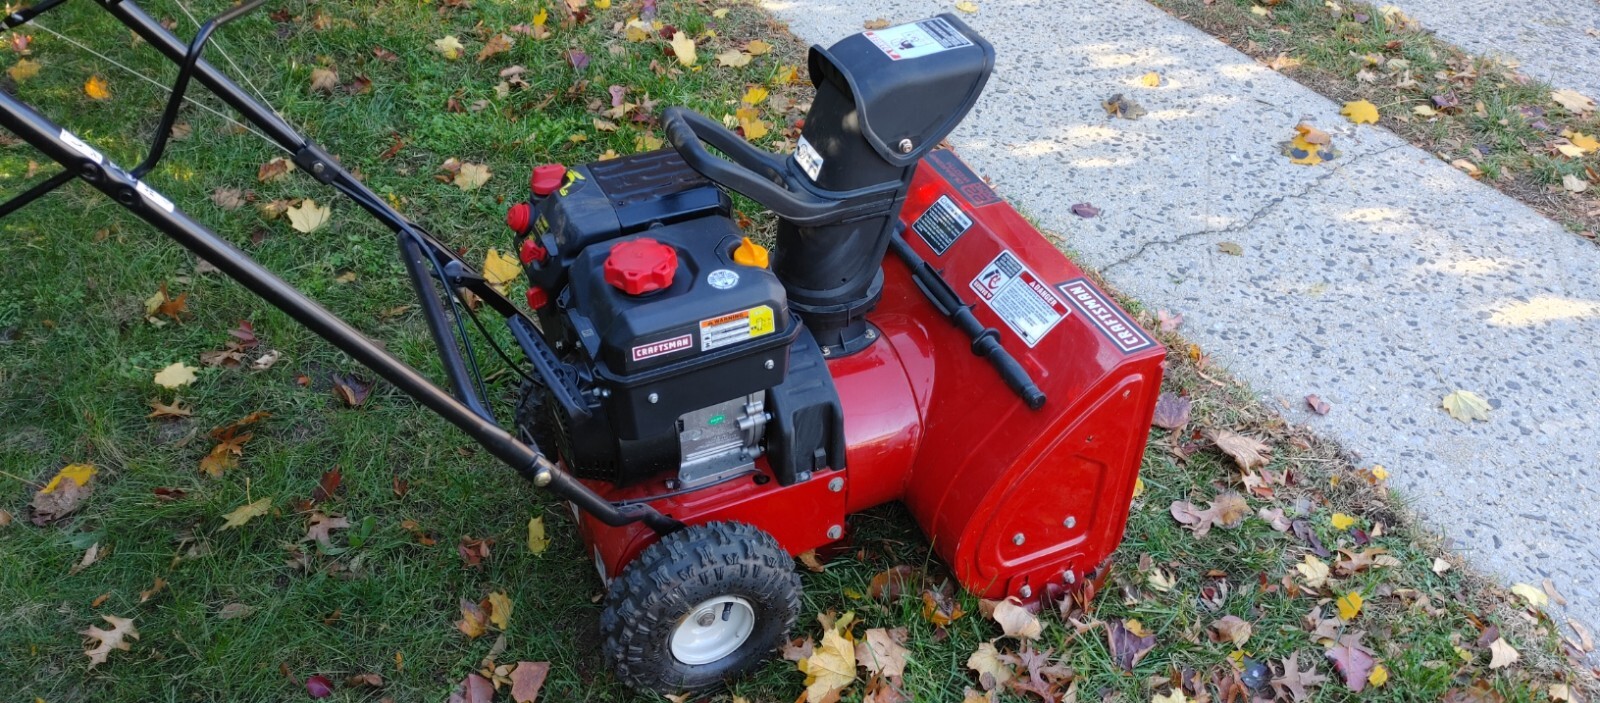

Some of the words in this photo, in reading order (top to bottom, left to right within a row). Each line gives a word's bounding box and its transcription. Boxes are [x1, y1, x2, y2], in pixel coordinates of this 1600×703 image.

[1034, 283, 1058, 307] DANGER
[714, 312, 744, 324] WARNING
[1069, 286, 1139, 345] CRAFTSMAN
[636, 337, 689, 357] CRAFTSMAN
